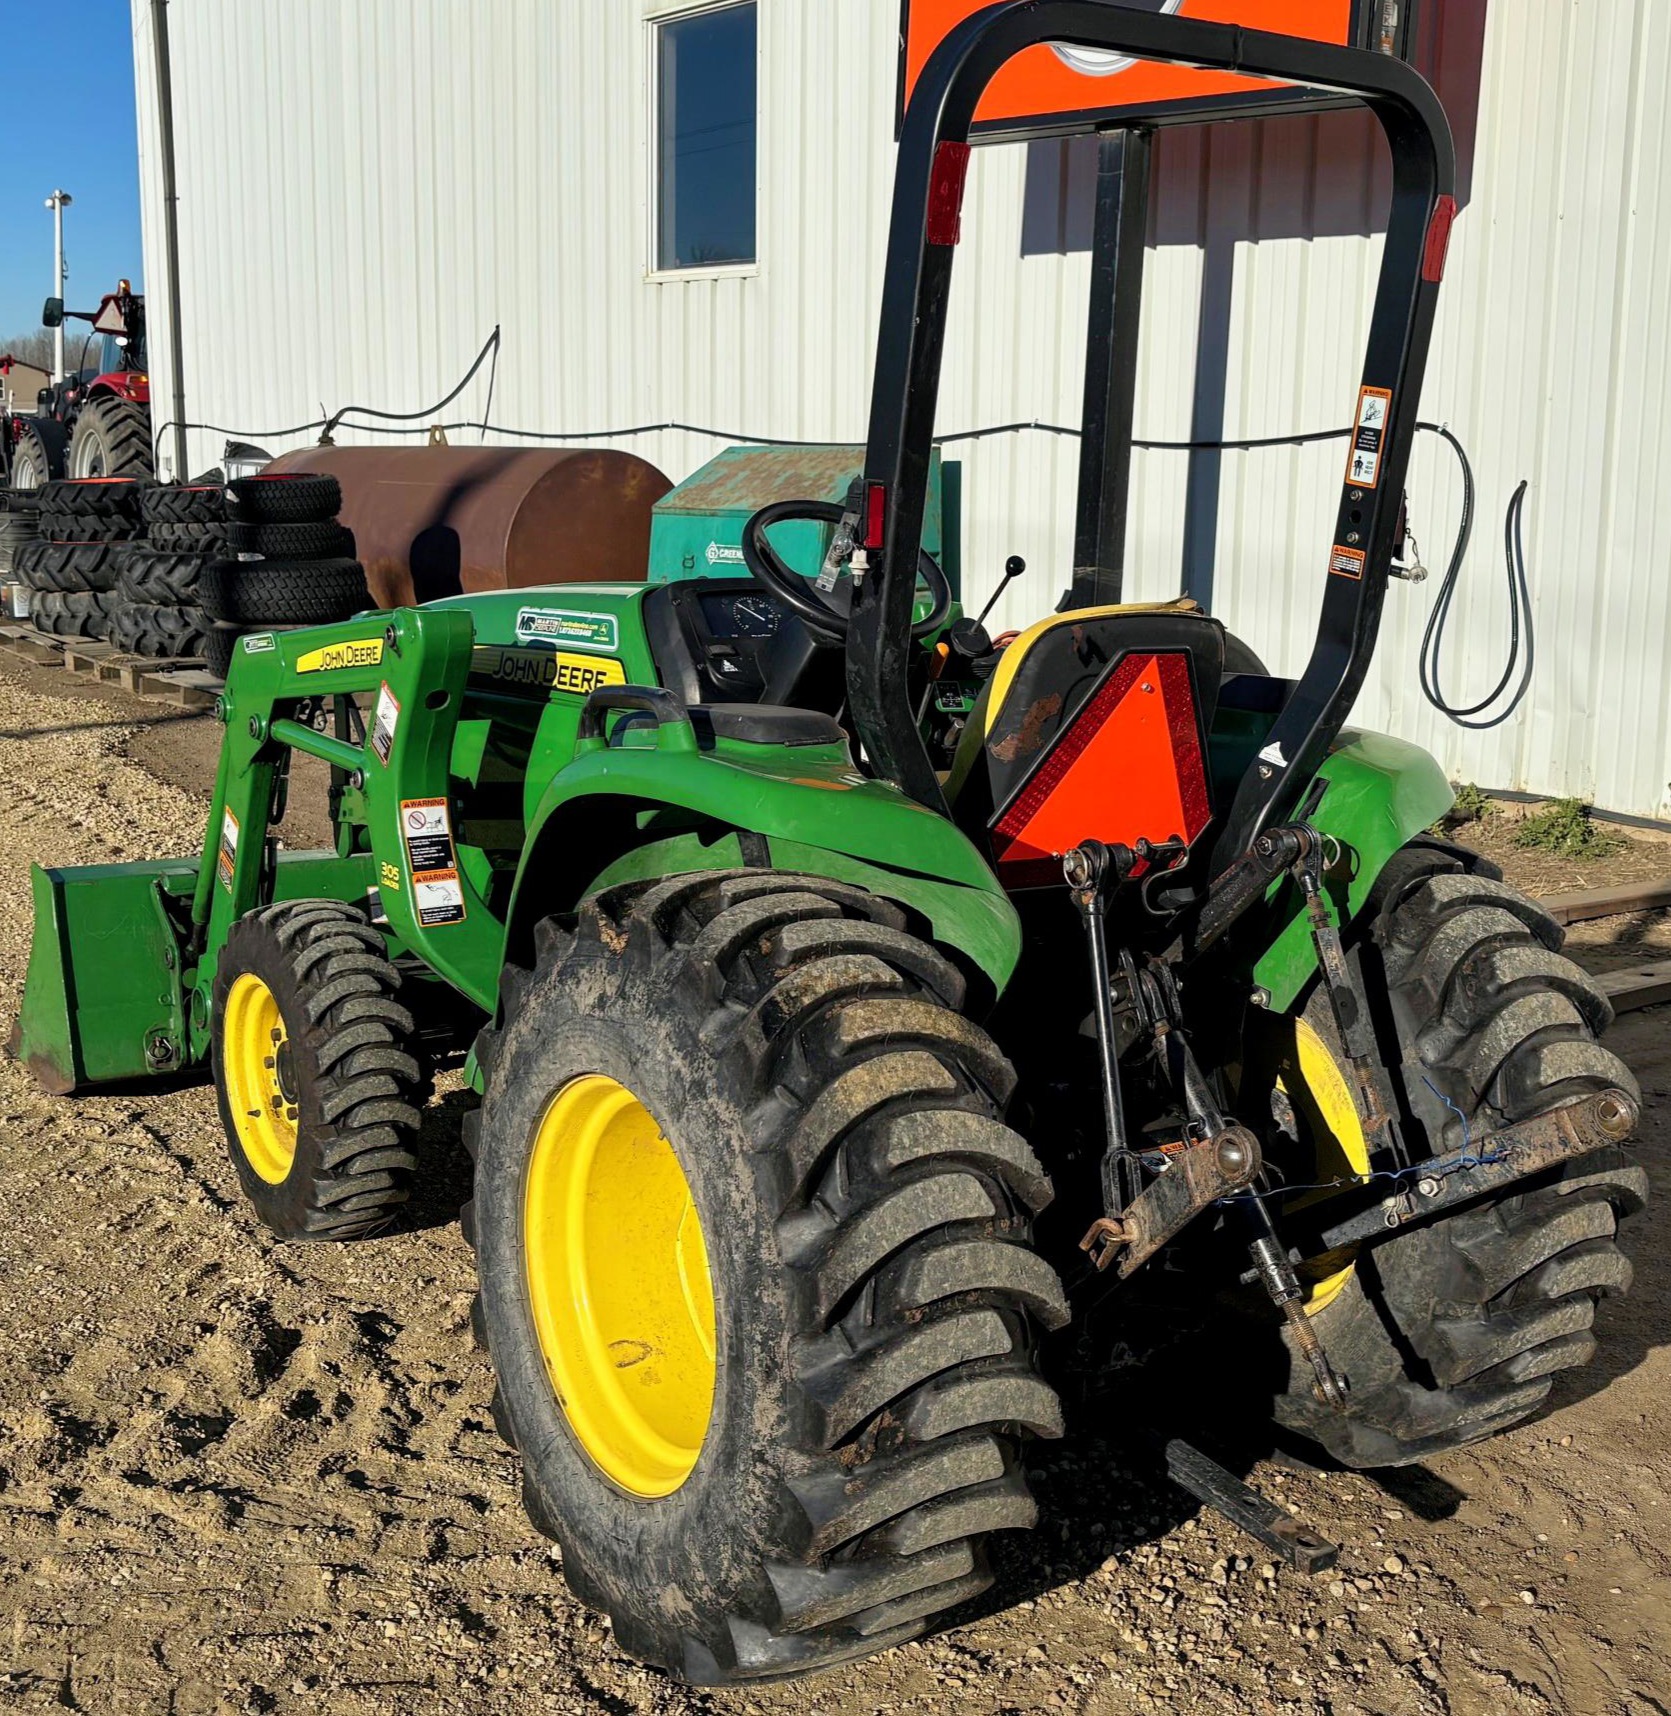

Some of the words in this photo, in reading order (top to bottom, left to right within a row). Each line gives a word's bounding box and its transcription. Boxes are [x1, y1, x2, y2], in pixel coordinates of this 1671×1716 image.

[320, 649, 345, 668] JOHN
[346, 645, 379, 664] DEERE
[492, 651, 540, 681] JOHN
[410, 798, 445, 808] WARNING
[381, 861, 400, 881] 305
[421, 872, 457, 883] WARNING
